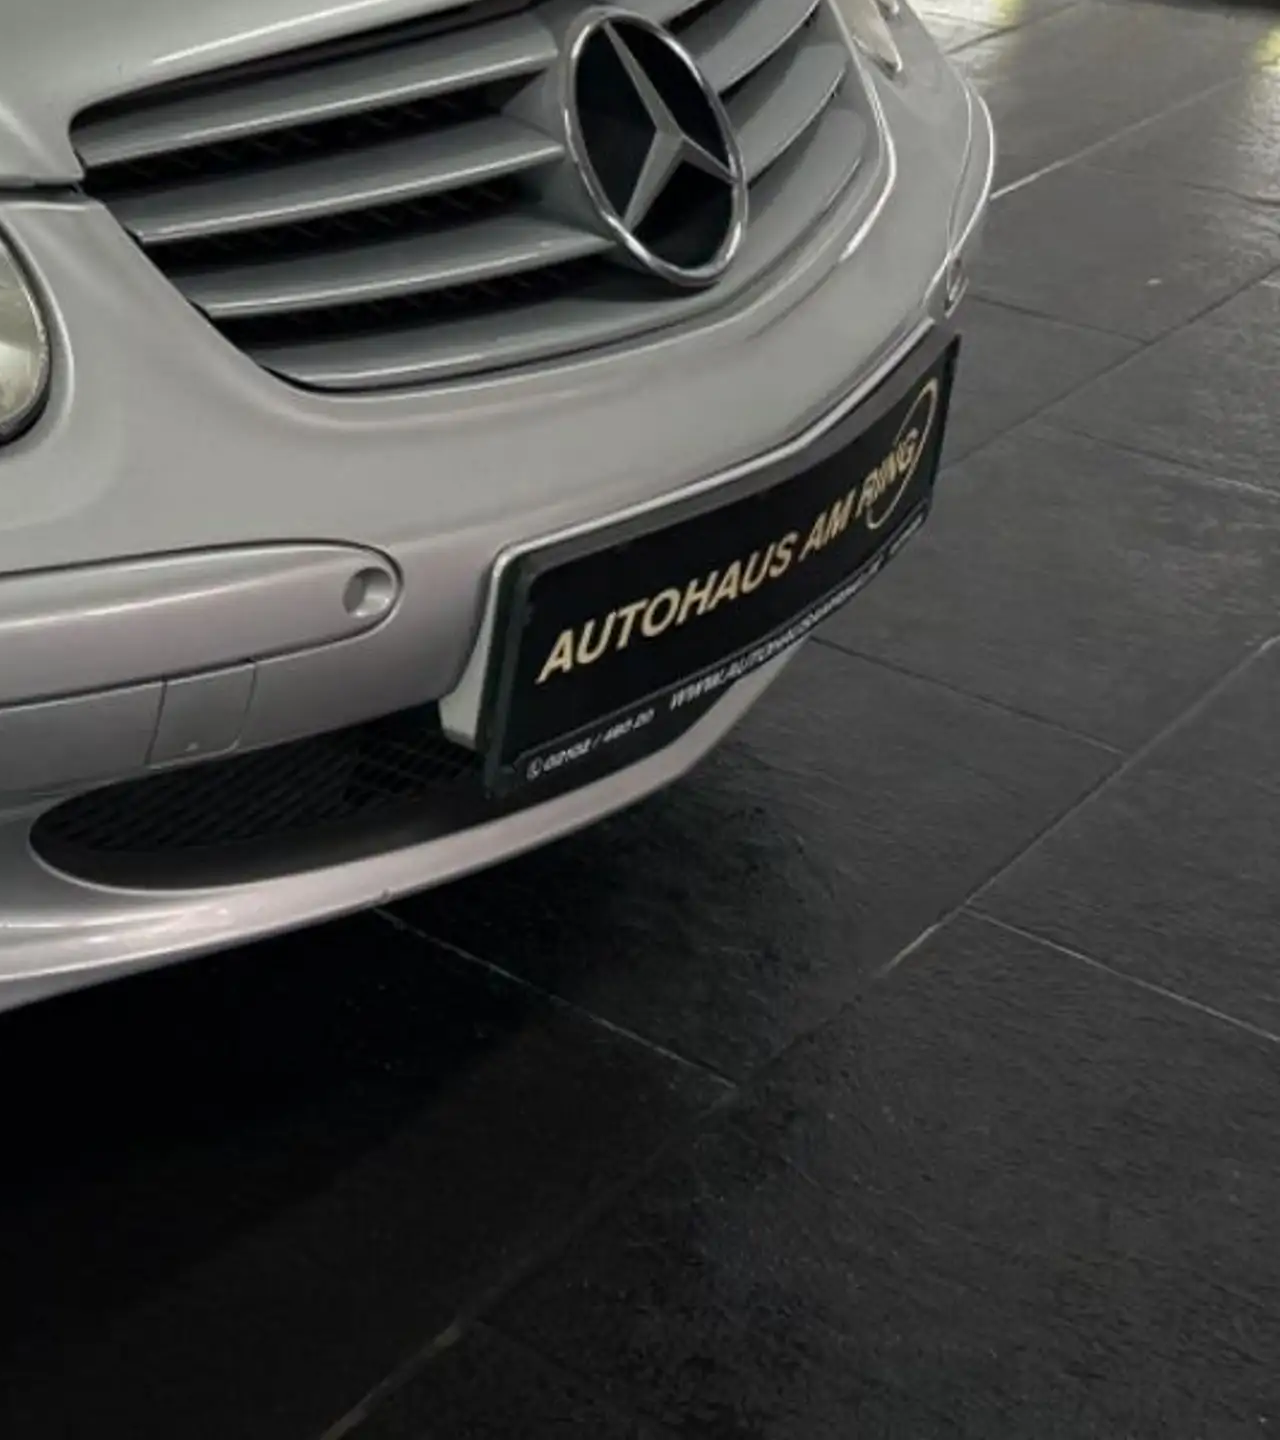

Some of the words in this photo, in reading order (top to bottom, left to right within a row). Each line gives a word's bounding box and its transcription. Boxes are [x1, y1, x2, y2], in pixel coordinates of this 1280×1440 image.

[536, 531, 800, 684] AUTOHAUS
[798, 487, 858, 561] AM
[854, 426, 921, 519] RING
